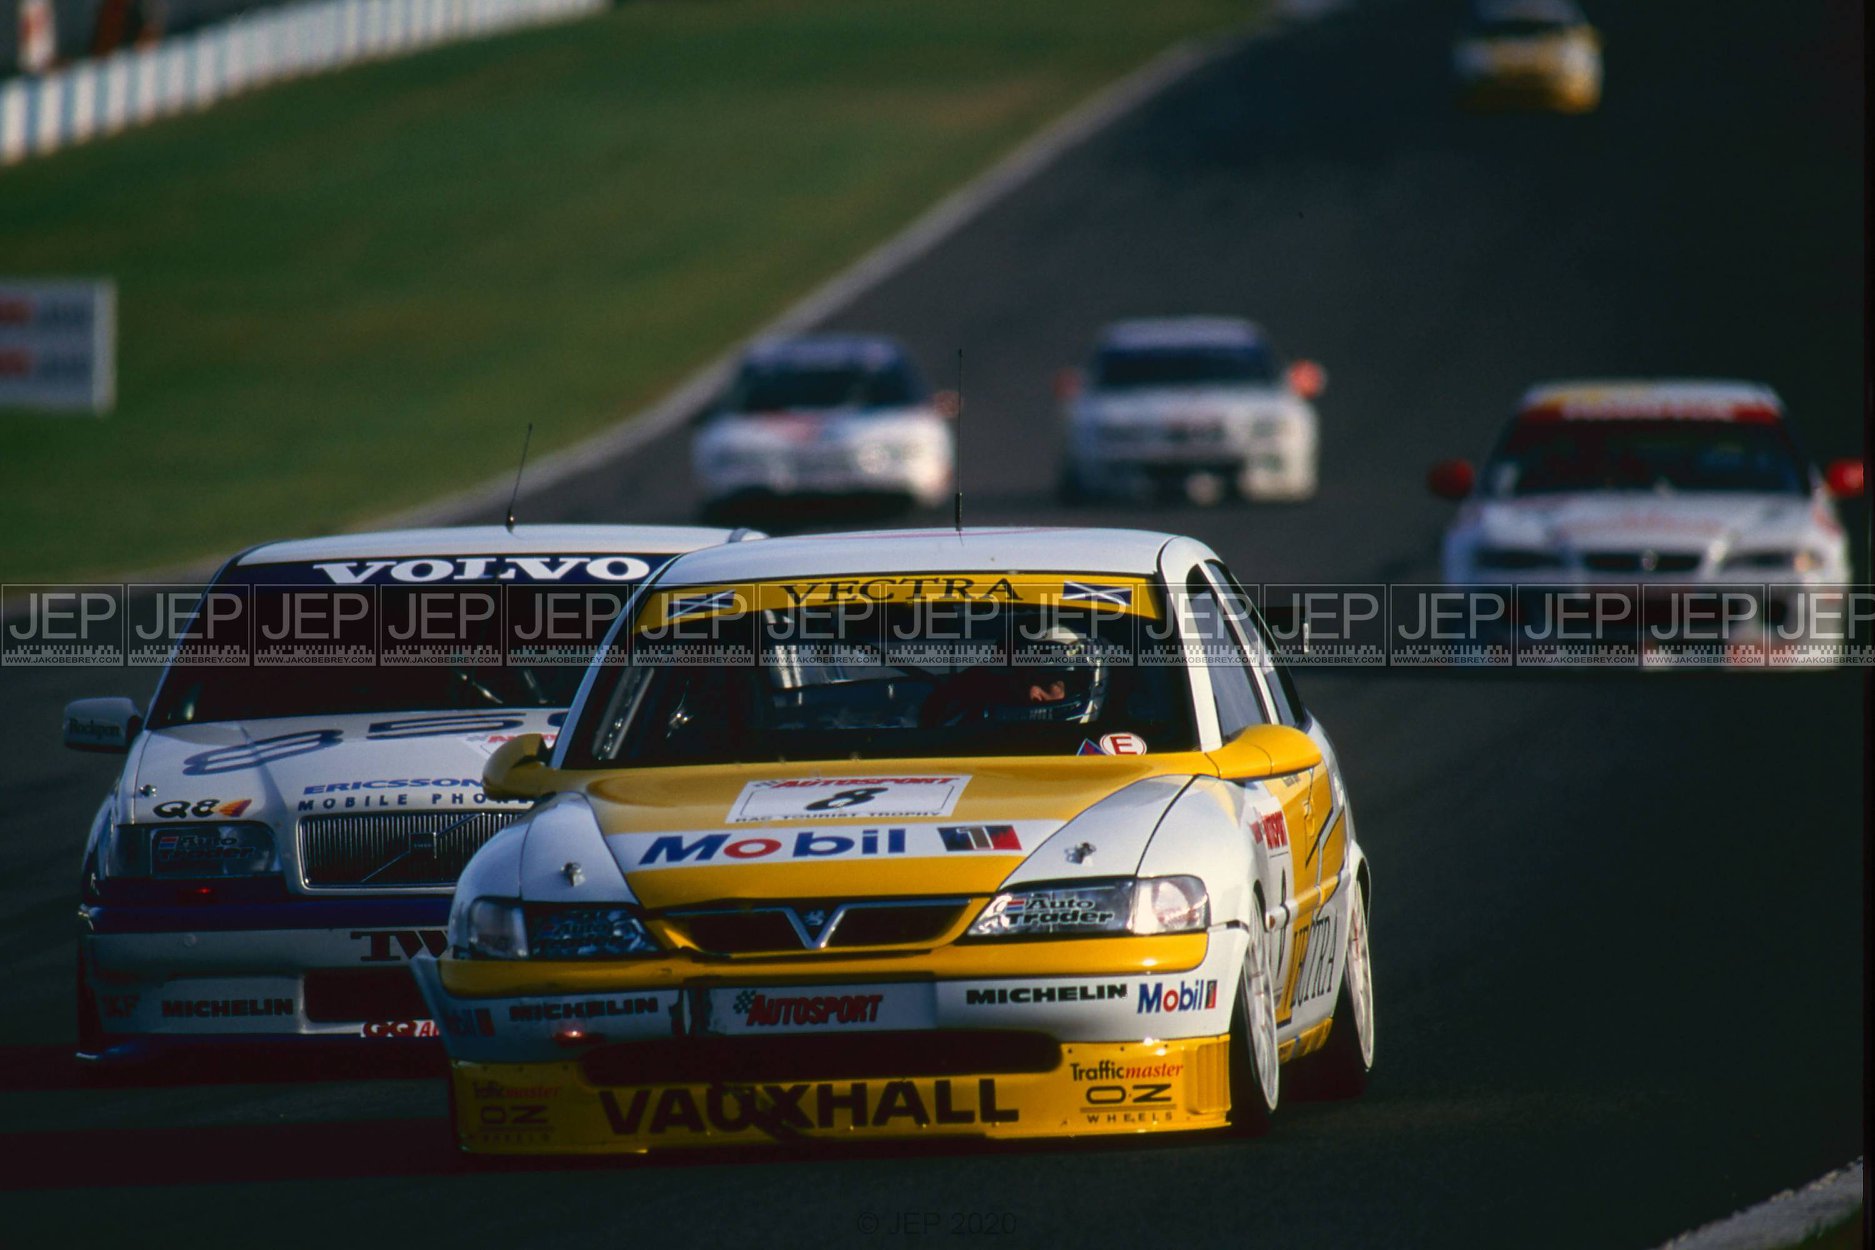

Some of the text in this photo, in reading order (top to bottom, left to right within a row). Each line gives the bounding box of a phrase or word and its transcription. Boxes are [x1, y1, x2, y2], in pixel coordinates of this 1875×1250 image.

[313, 556, 650, 584] VOLVO
[780, 577, 1023, 604] VECTRA
[183, 712, 568, 775] 85
[1110, 736, 1138, 755] E
[303, 778, 484, 795] ERICSSON
[770, 777, 960, 789] AUTOSPORT
[154, 800, 219, 819] Q8
[298, 792, 528, 811] MOBILE PHO
[804, 787, 889, 811] 8
[783, 812, 859, 820] TOURIST
[638, 828, 906, 865] Mobil
[1026, 898, 1095, 909] Auto
[1006, 910, 1114, 925] Trader
[965, 984, 1128, 1005] MICHELIN
[1137, 980, 1204, 1013] Mobil
[161, 998, 294, 1018] MICHELIN
[509, 998, 659, 1021] MICHELIN
[747, 993, 884, 1026] AUTOSPORT
[1070, 1059, 1184, 1081] Trafficmaster
[1085, 1083, 1172, 1104] OZ
[599, 1079, 1020, 1134] VAUXHALL
[1086, 1111, 1173, 1124] WHEELS
